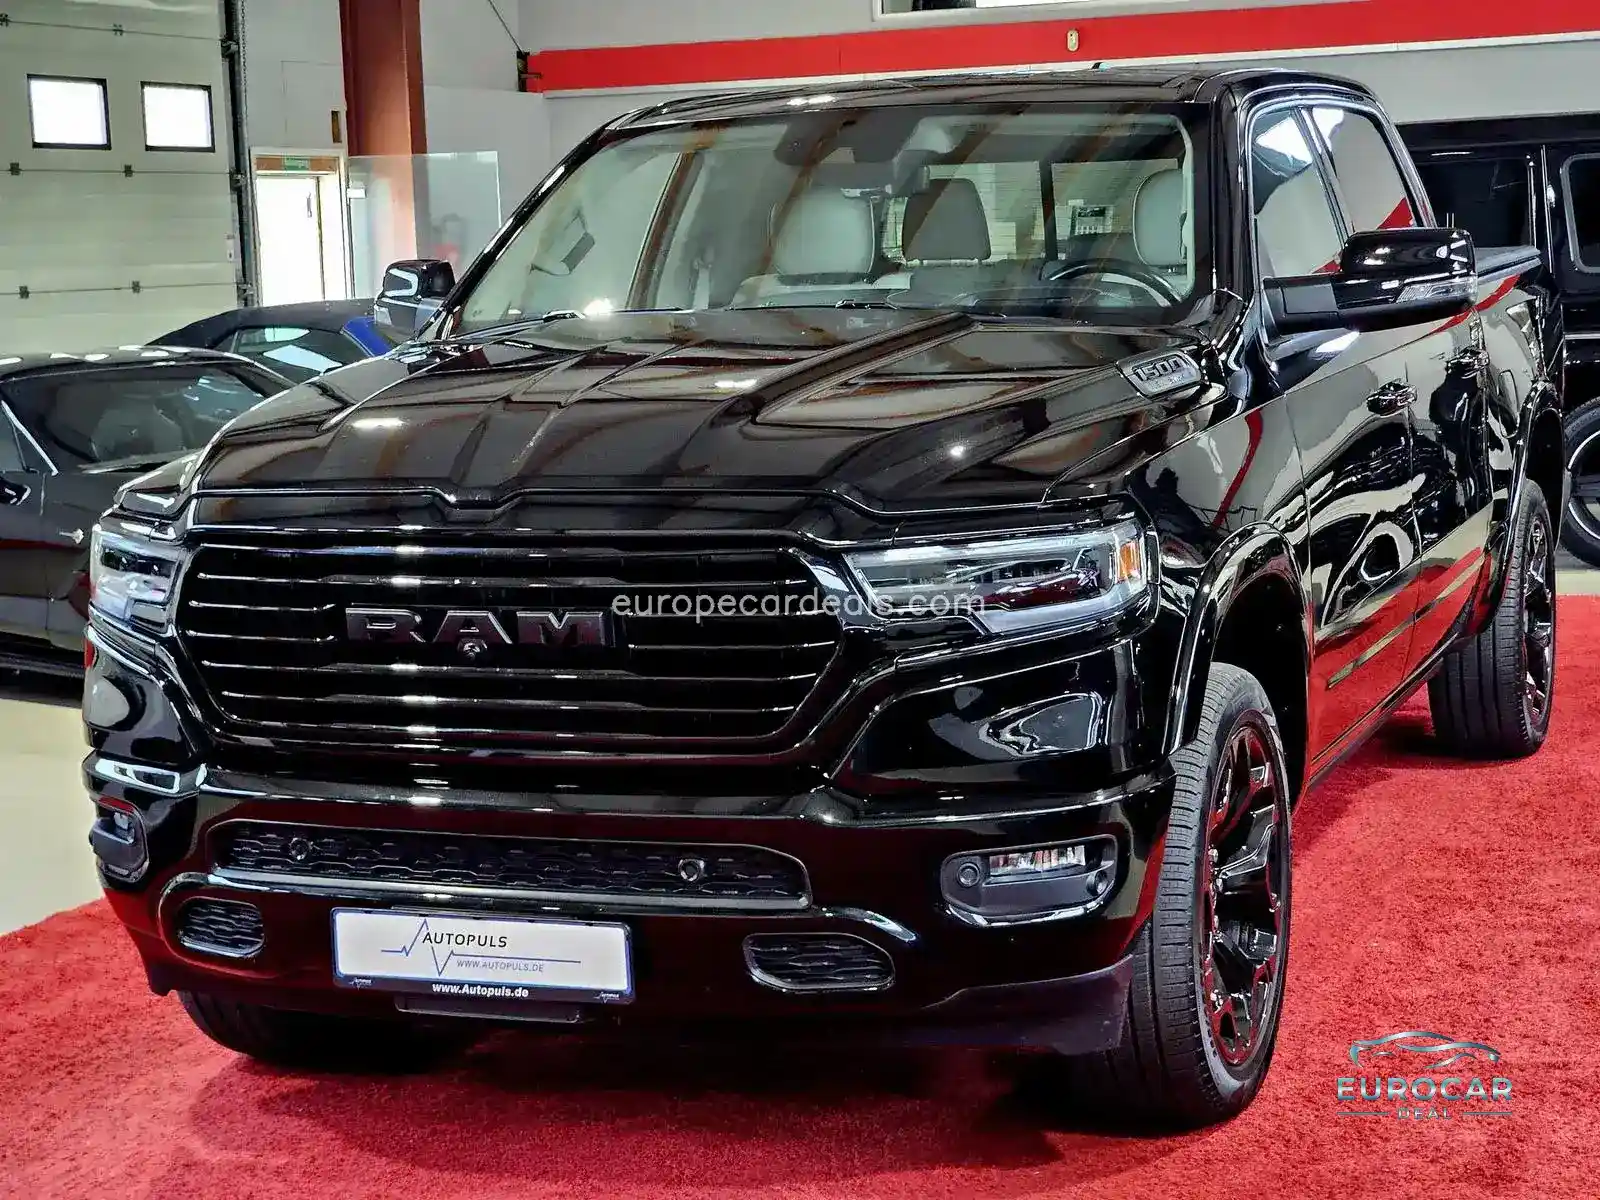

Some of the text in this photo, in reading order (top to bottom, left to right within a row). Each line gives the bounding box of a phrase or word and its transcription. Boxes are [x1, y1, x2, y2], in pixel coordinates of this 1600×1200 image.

[1134, 357, 1187, 381] 1500
[345, 608, 604, 645] RAM
[422, 932, 508, 948] AUTOPULS
[456, 959, 545, 973] WWW.AUTOPULS.DE
[432, 982, 529, 998] www.Autopuls.de
